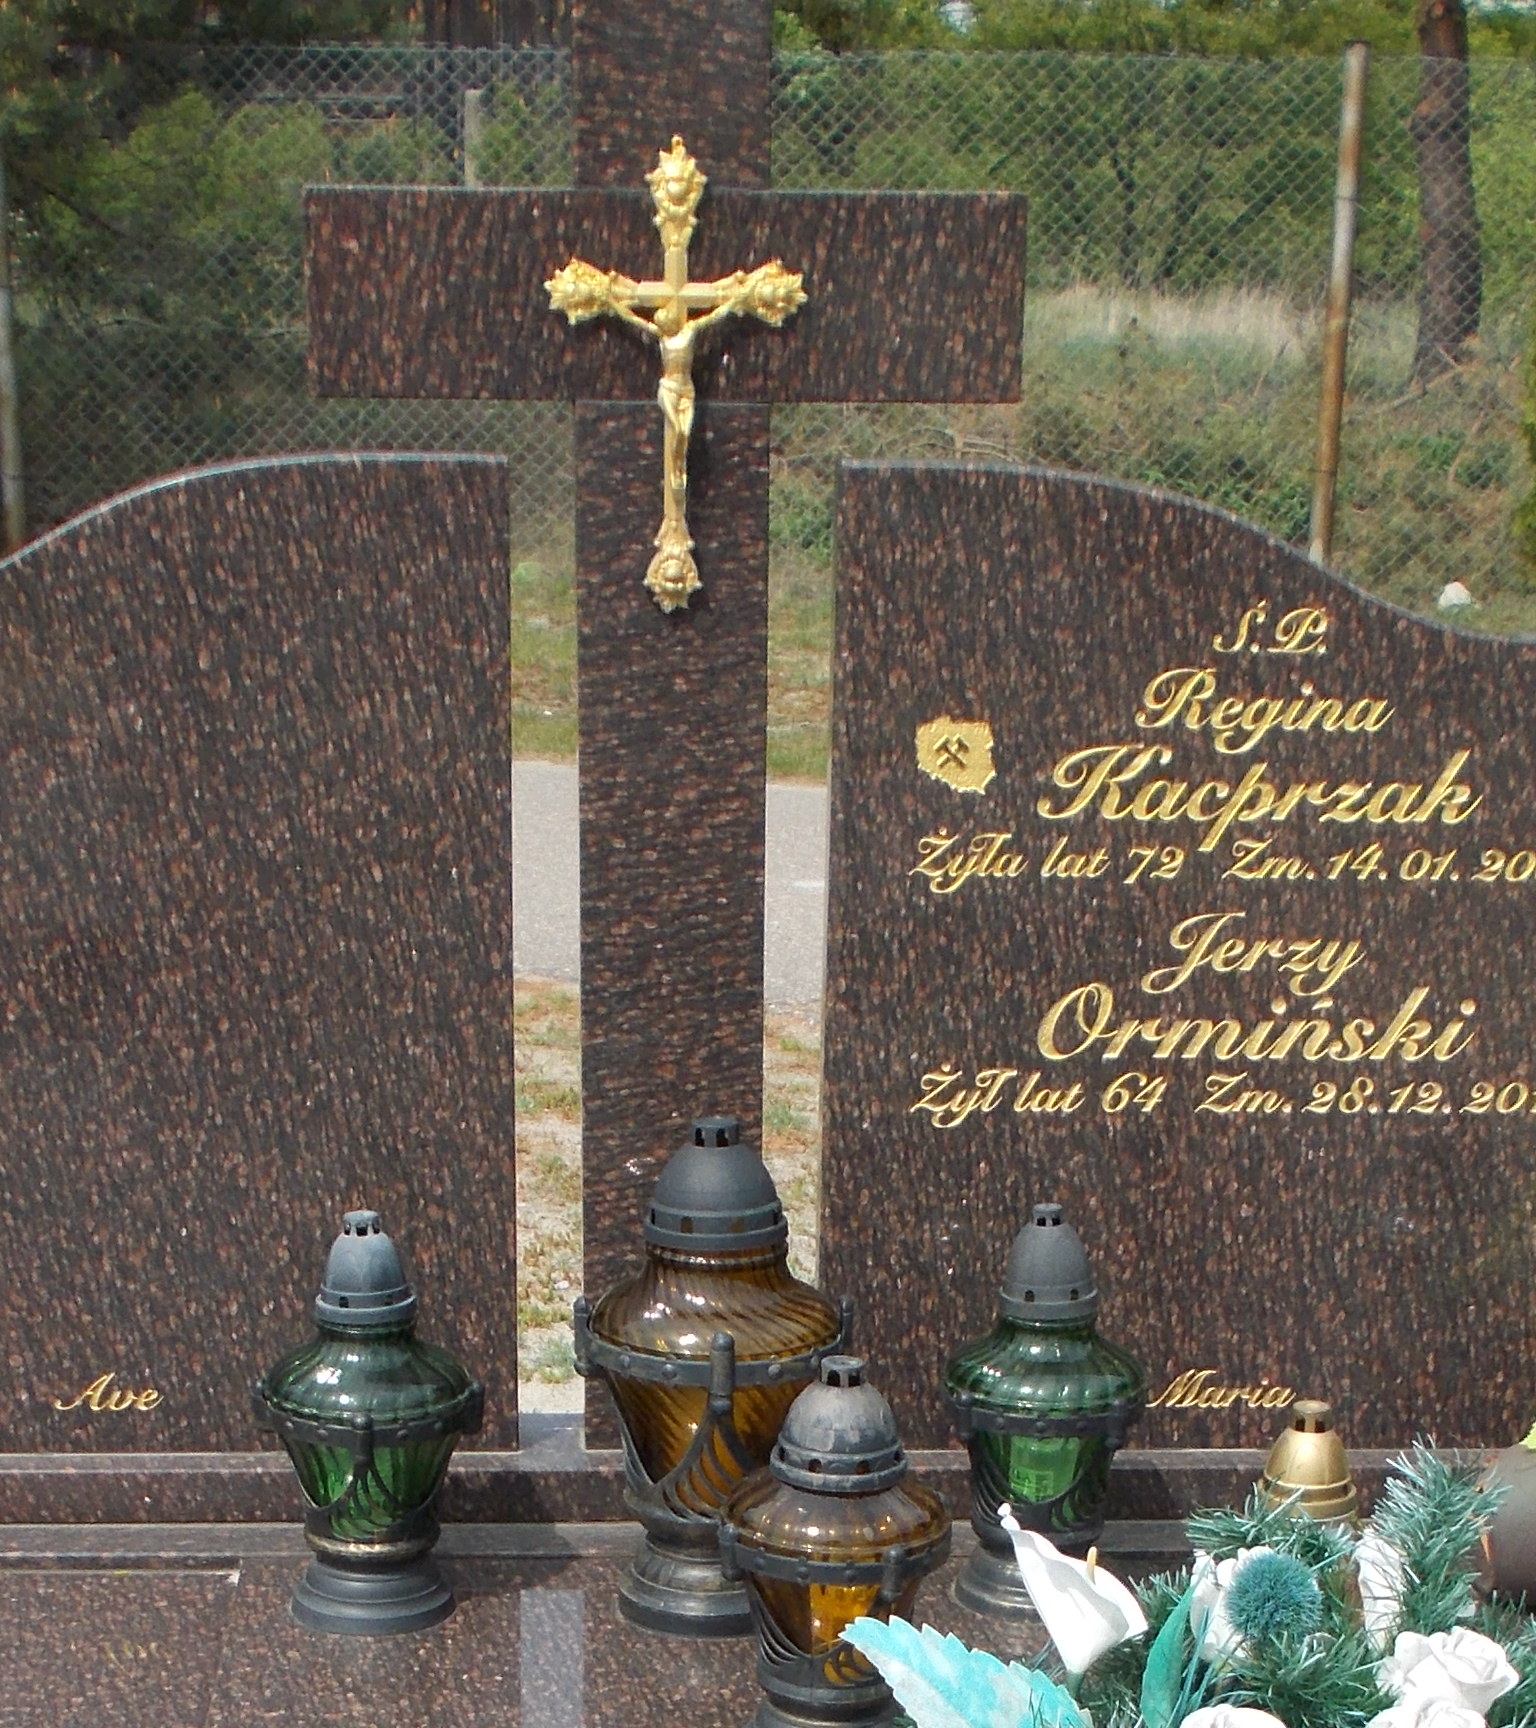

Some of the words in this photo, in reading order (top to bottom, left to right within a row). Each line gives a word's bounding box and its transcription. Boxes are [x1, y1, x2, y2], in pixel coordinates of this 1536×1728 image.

[1134, 667, 1396, 755] Regina
[1036, 743, 1484, 853] Kacprzak
[1040, 836, 1111, 878] lat
[1123, 845, 1185, 884] 72
[1221, 838, 1316, 881] Zm.
[1140, 911, 1364, 996] Jerzy
[1037, 982, 1476, 1061] Ormiński
[1014, 1072, 1086, 1113] lat
[1101, 1072, 1168, 1113] 64
[1194, 1072, 1292, 1114] Zm.
[54, 1372, 164, 1411] Ave
[1145, 1369, 1297, 1408] Maria
